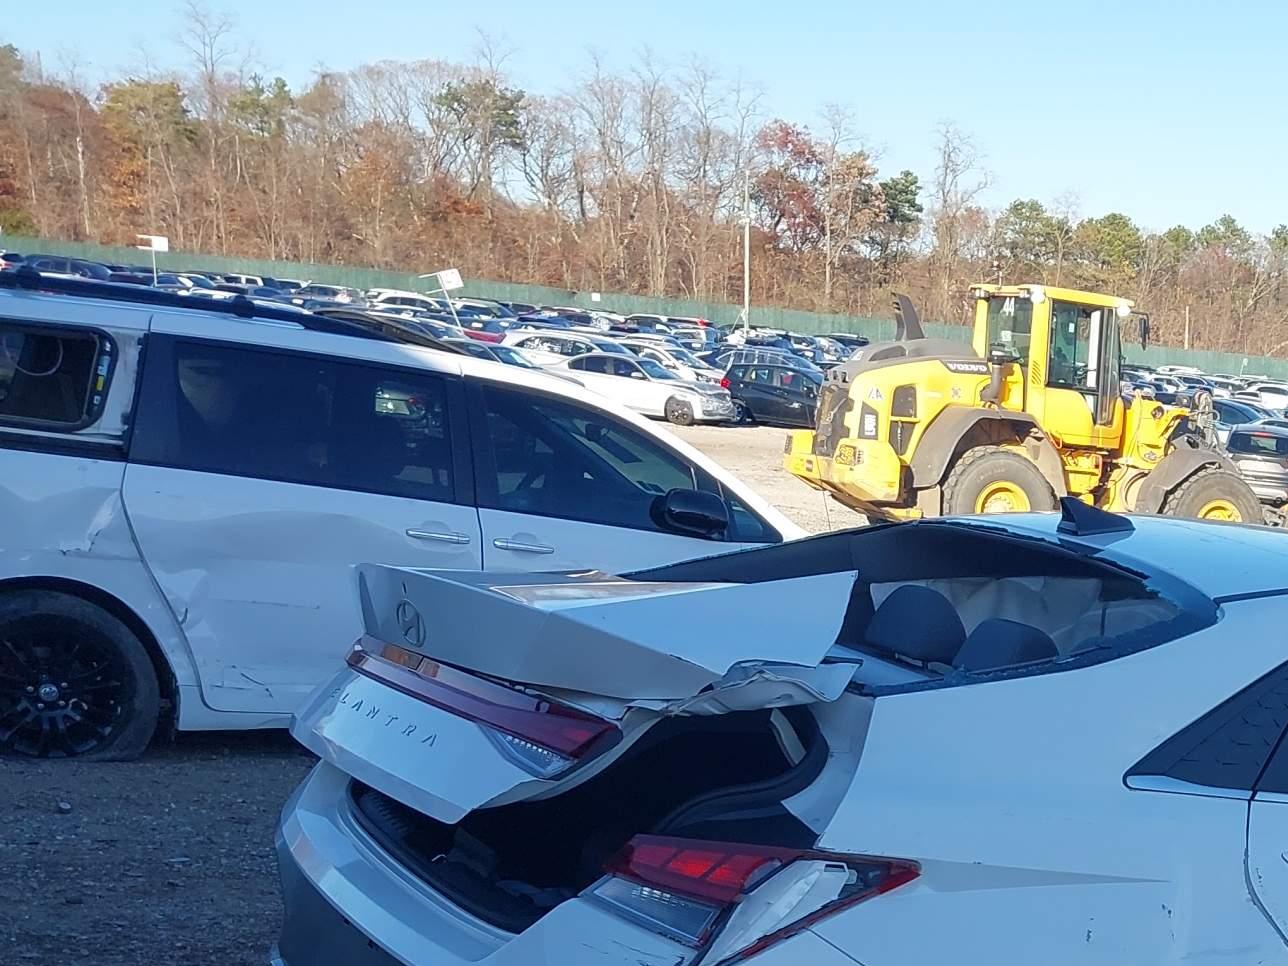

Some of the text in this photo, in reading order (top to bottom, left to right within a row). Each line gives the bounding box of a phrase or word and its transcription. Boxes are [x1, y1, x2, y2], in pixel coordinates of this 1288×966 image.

[1001, 296, 1016, 317] 44
[946, 363, 988, 373] VOLVO
[329, 687, 439, 748] ELANTRA
